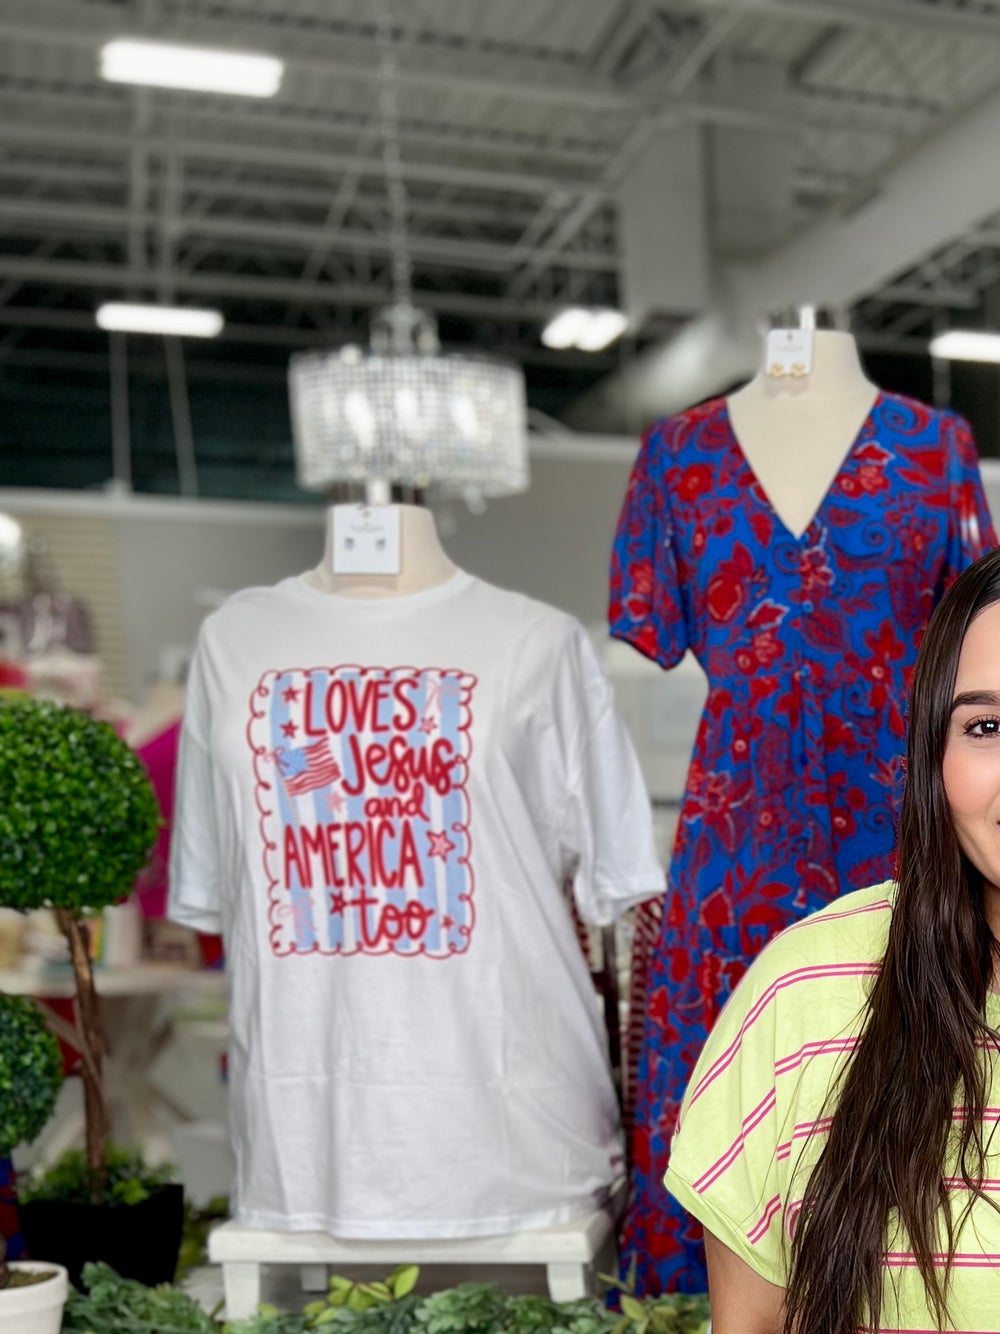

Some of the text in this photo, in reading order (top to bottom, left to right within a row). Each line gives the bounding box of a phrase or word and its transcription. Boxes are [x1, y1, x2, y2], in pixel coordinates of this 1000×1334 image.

[304, 678, 419, 736] LOVES
[341, 733, 456, 796] Jesus
[364, 782, 430, 822] and
[284, 819, 424, 890] AMERICA
[350, 887, 434, 948] too
